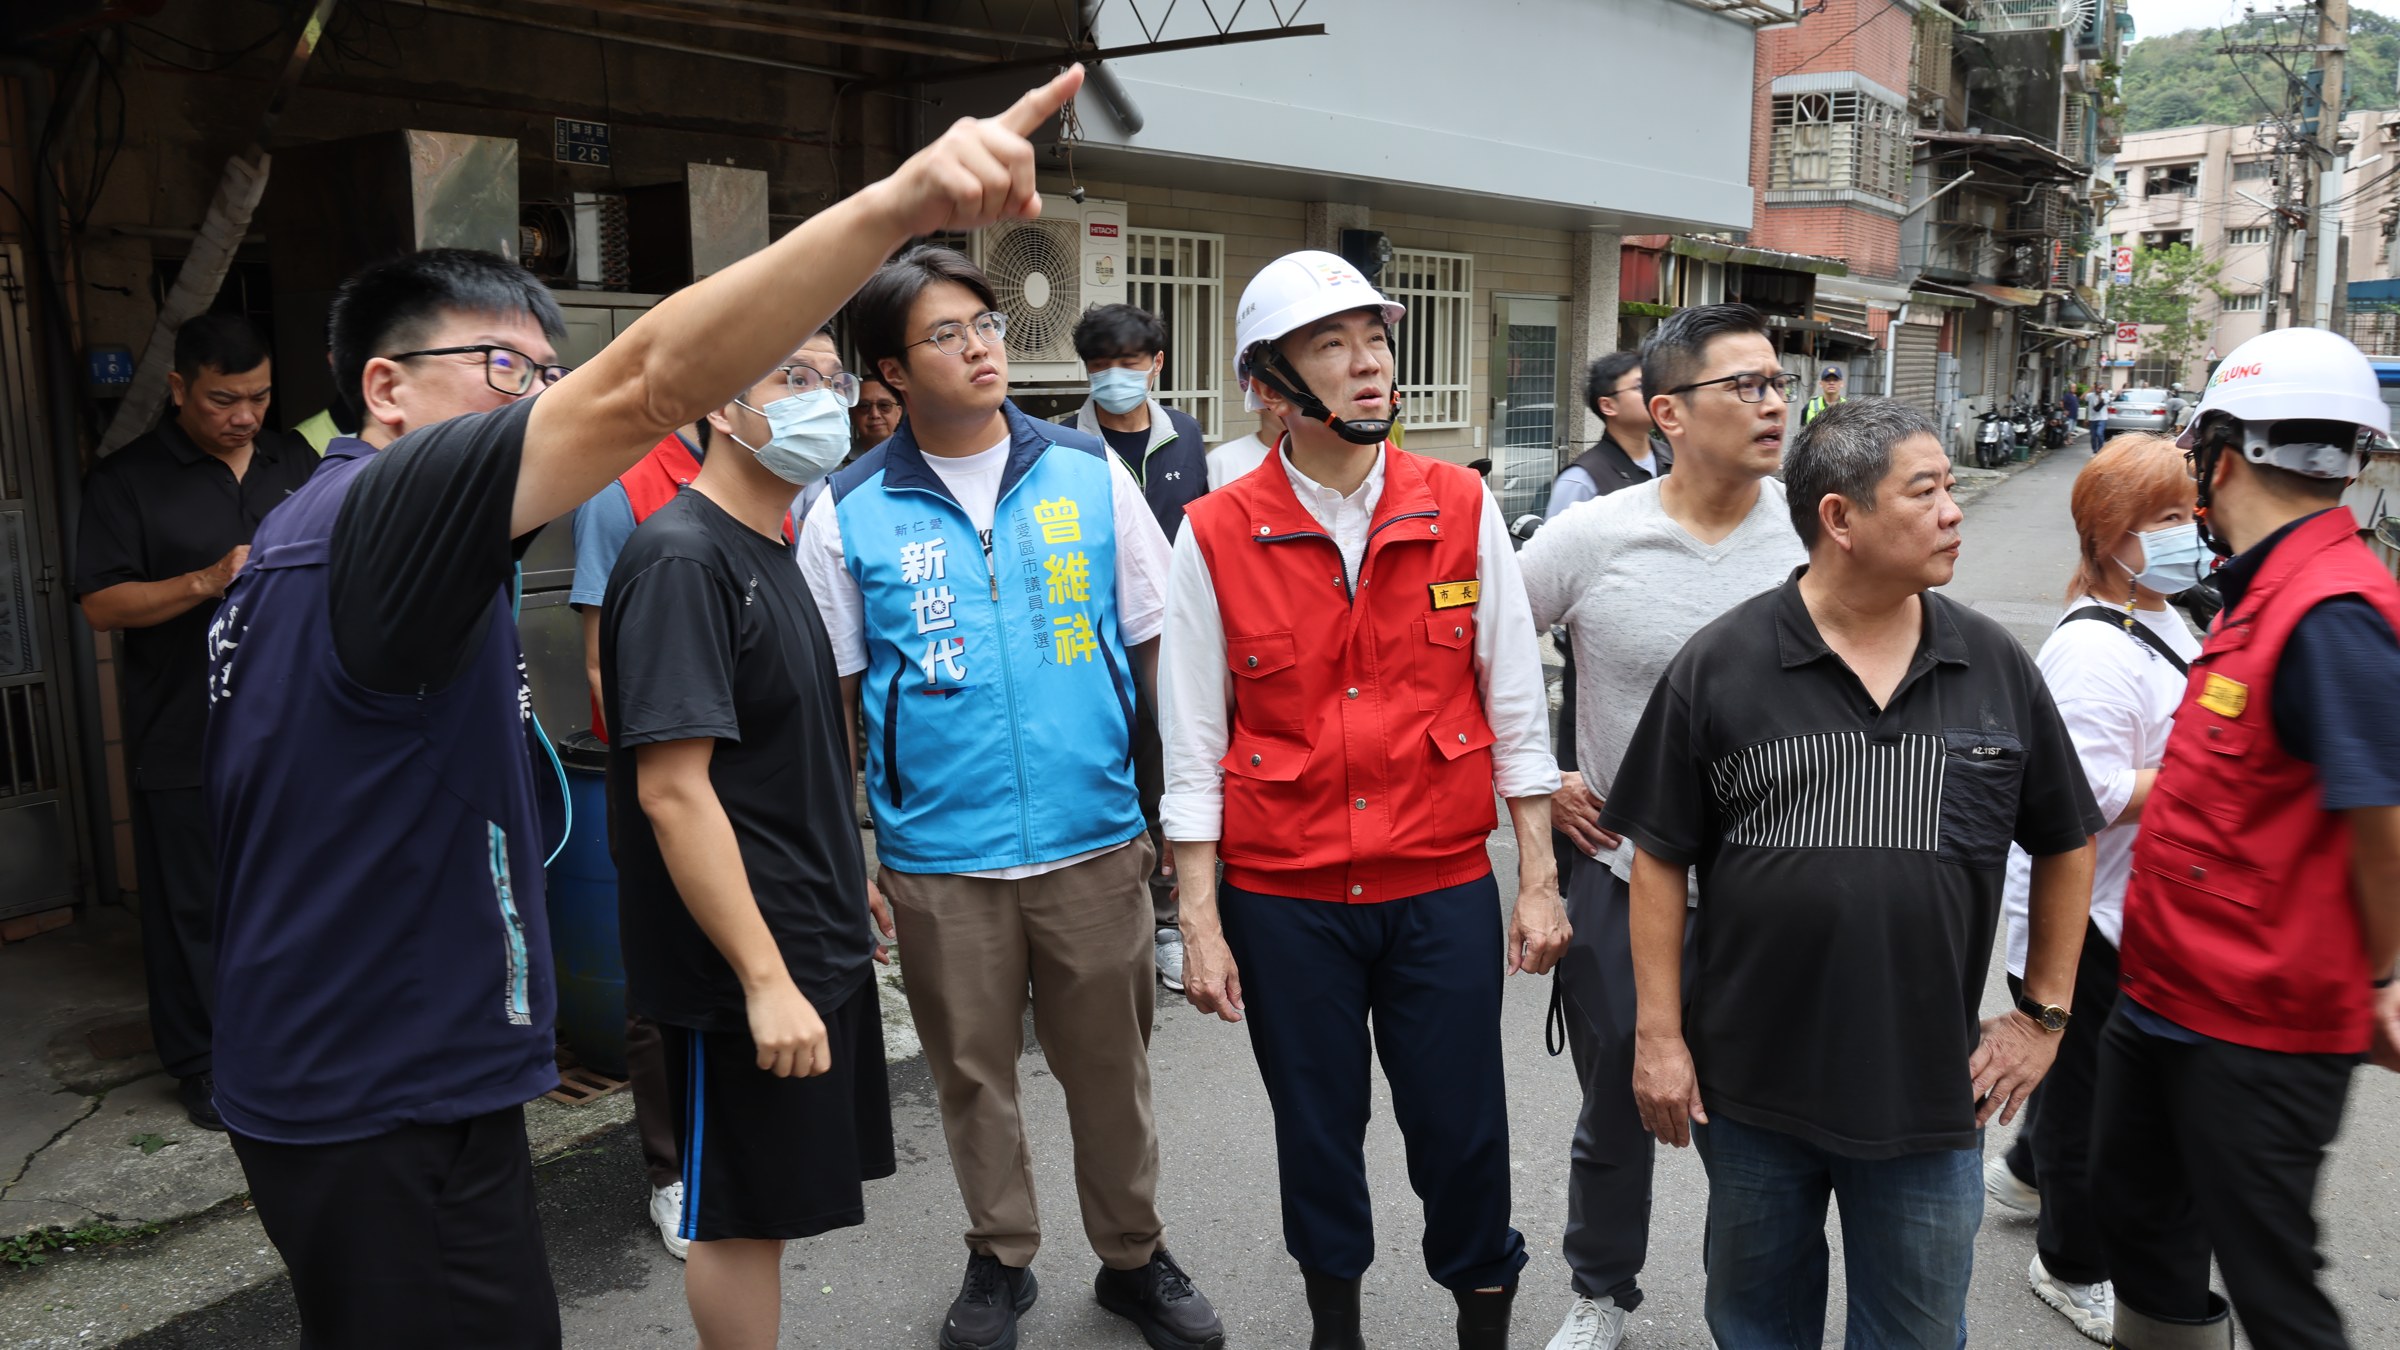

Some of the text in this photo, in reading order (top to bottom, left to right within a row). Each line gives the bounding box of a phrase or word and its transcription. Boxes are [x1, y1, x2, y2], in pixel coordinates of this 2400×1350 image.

[577, 146, 600, 161] 26
[1090, 226, 1117, 235] HITACHI
[2117, 254, 2131, 267] OK
[2117, 327, 2137, 339] OK
[894, 517, 943, 537] 新仁愛
[1011, 507, 1053, 668] 仁愛區市議員參選人
[1033, 496, 1098, 666] 曾維祥
[1440, 585, 1472, 602] 市長
[900, 537, 967, 685] 新世代
